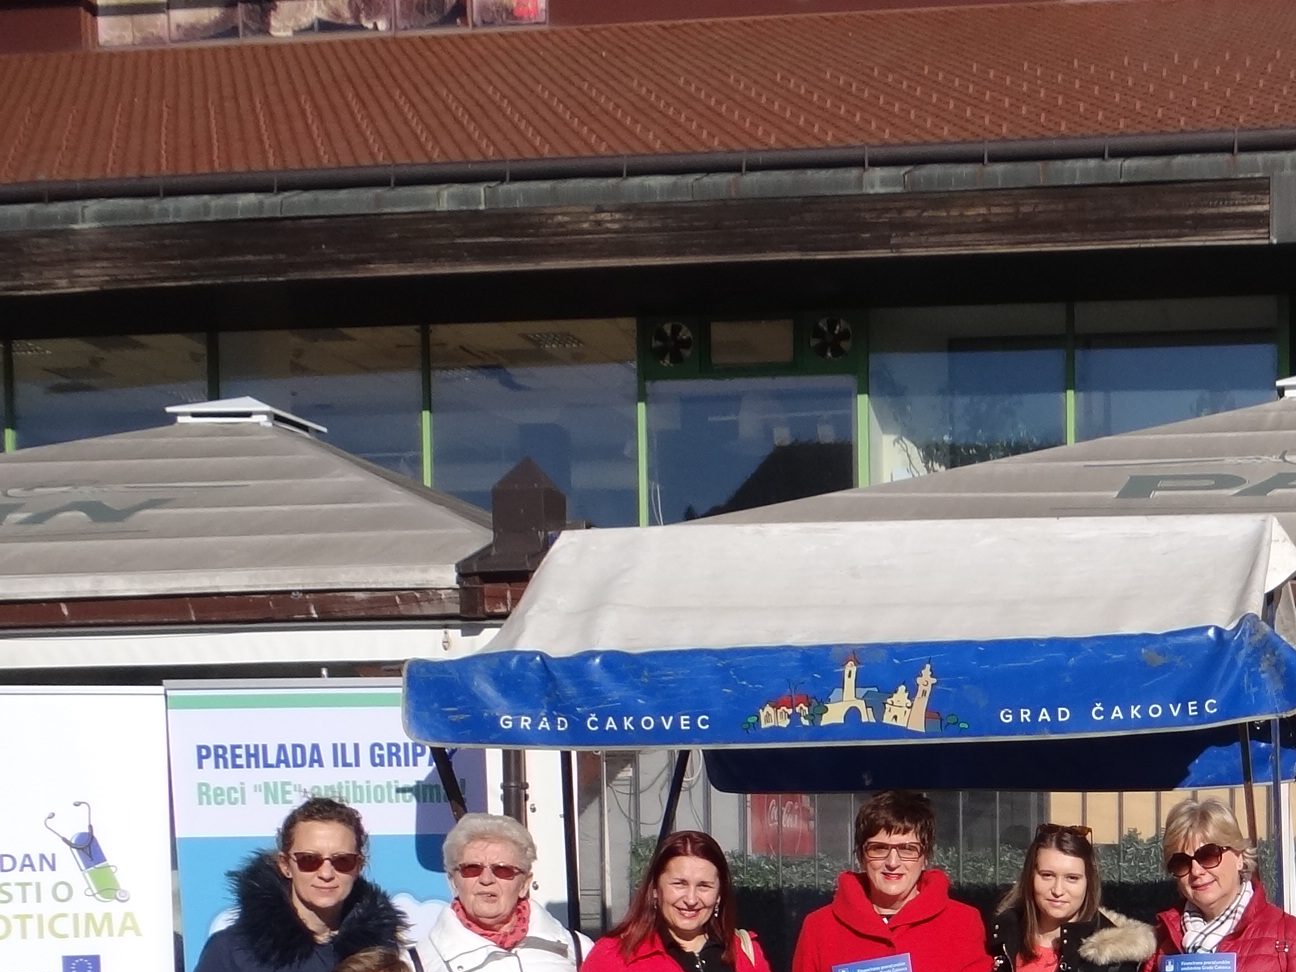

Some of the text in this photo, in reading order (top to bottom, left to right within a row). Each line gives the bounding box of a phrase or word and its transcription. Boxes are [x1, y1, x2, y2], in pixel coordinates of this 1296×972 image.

[500, 711, 711, 731] GRAD ČAKOVEC
[1000, 698, 1219, 723] GRAD ČAKOVEC
[196, 743, 324, 770] PREHLADA
[332, 742, 361, 768] ILI
[197, 781, 246, 806] Reci
[254, 780, 301, 805] "NE"
[0, 853, 57, 873] DAN
[51, 881, 74, 903] O
